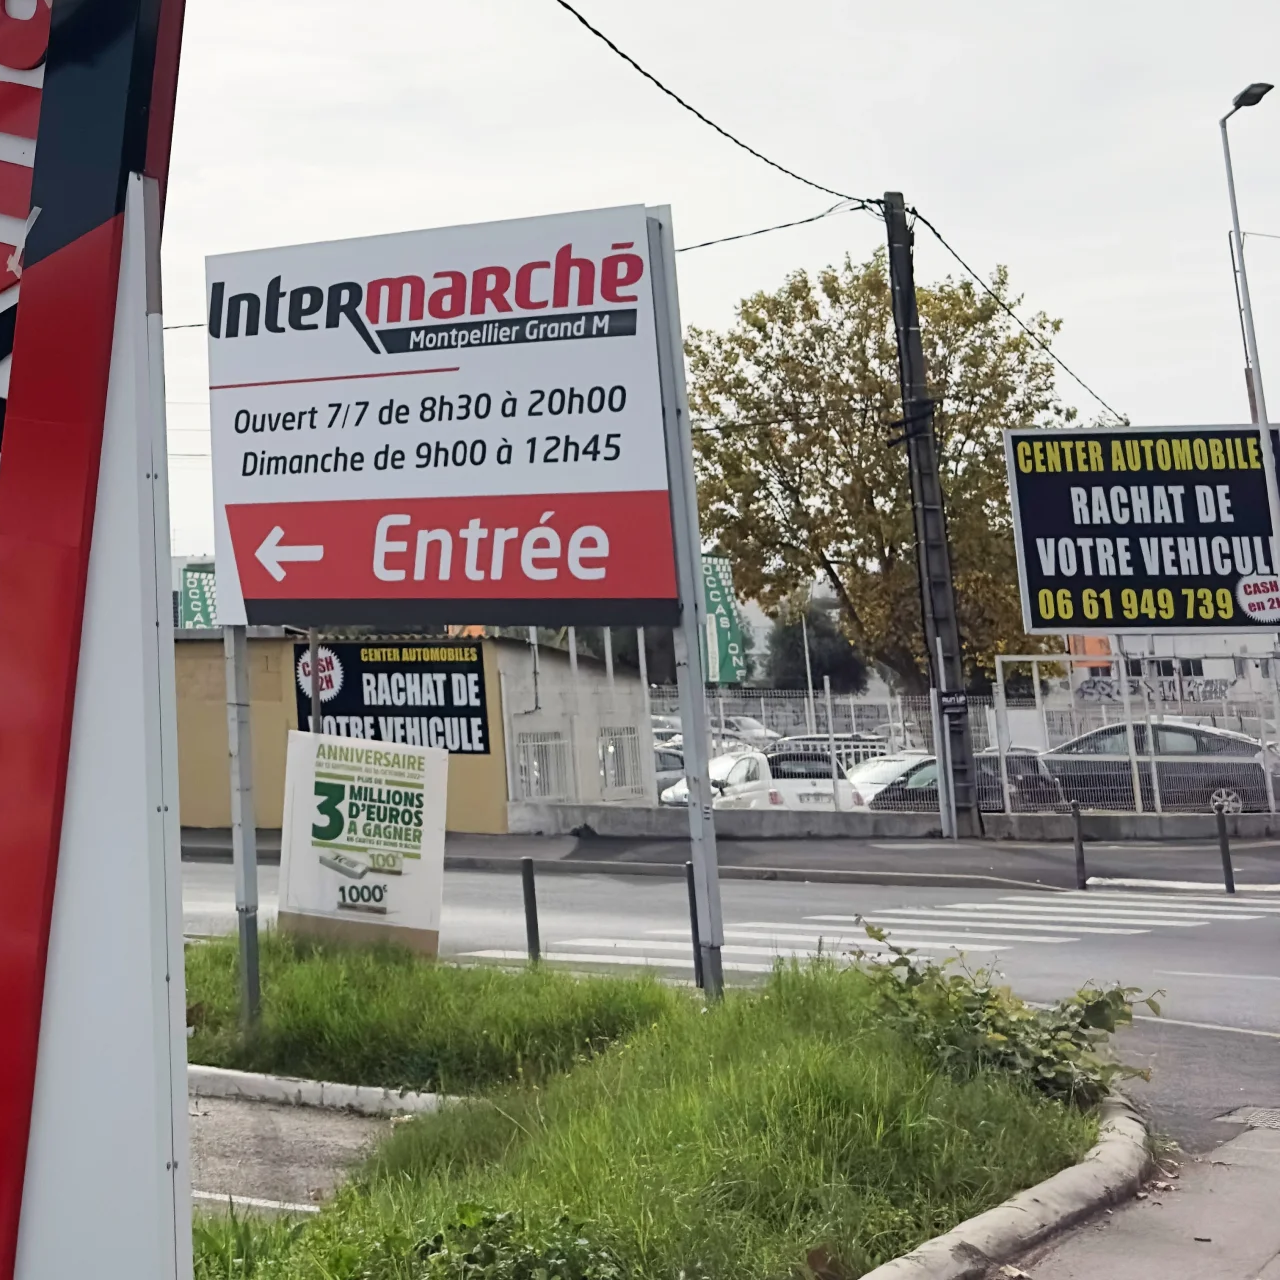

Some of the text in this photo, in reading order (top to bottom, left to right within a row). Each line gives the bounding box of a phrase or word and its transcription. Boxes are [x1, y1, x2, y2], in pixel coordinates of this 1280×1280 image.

[409, 314, 610, 350] Montpellier Grand M
[234, 385, 627, 434] Ouvert 7/7 de 8h30 à 20h00
[241, 433, 622, 477] Dimanche de 9h00 à 12h45
[1017, 436, 1262, 474] CENTER AUTOMOBILE
[1070, 484, 1235, 525] RACHAT DE
[371, 510, 610, 585] Entrée
[1036, 537, 1134, 577] VOTRE
[1038, 587, 1234, 620] 06 61 949 739
[1243, 580, 1280, 596] CASH
[302, 655, 335, 678] CSH
[360, 647, 478, 663] CENTER AUTOMOBILES
[362, 672, 481, 707] RACHAT DE
[378, 715, 485, 752] VEHICULE
[316, 743, 425, 772] ANNIVERSAIRE
[312, 780, 346, 841] 3
[349, 784, 425, 809] MILLIONS
[348, 801, 424, 828] D'EUROS
[363, 822, 423, 844] GAGNER
